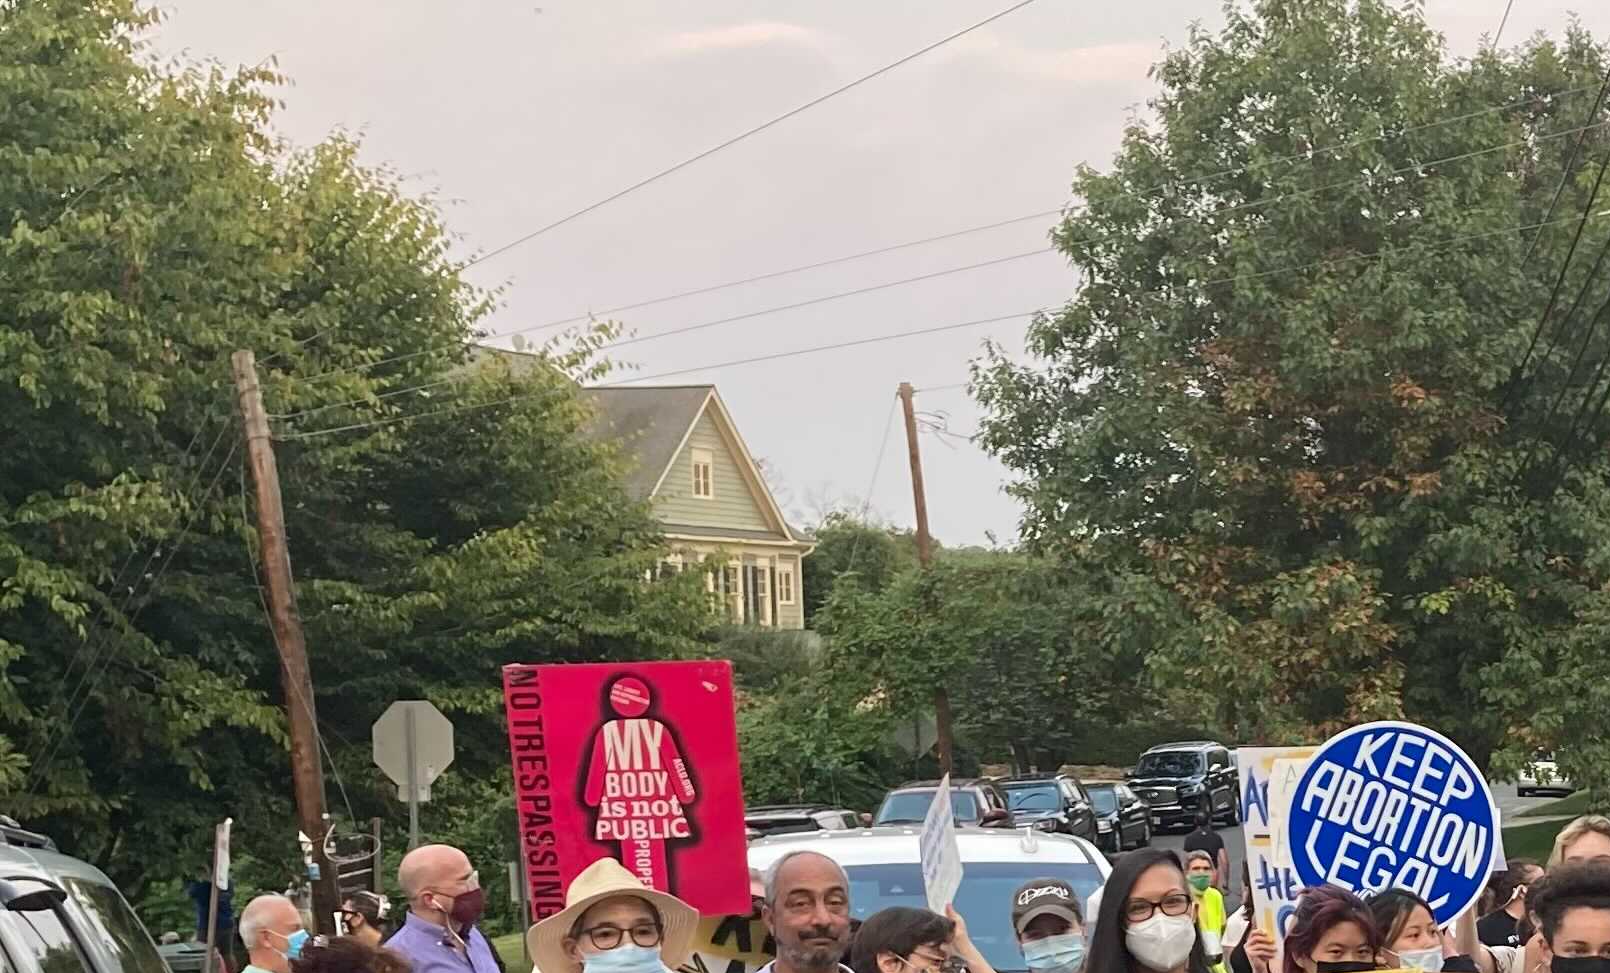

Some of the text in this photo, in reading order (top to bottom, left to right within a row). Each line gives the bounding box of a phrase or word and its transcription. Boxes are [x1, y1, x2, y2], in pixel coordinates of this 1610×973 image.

[602, 719, 664, 770] MY
[1353, 732, 1475, 801] KEEP
[600, 795, 684, 818] is not
[605, 771, 669, 798] BODY
[595, 818, 691, 841] PUBLIC
[1301, 760, 1487, 879] ABORTION
[635, 840, 654, 890] PROPE
[1305, 819, 1451, 910] LEGAL
